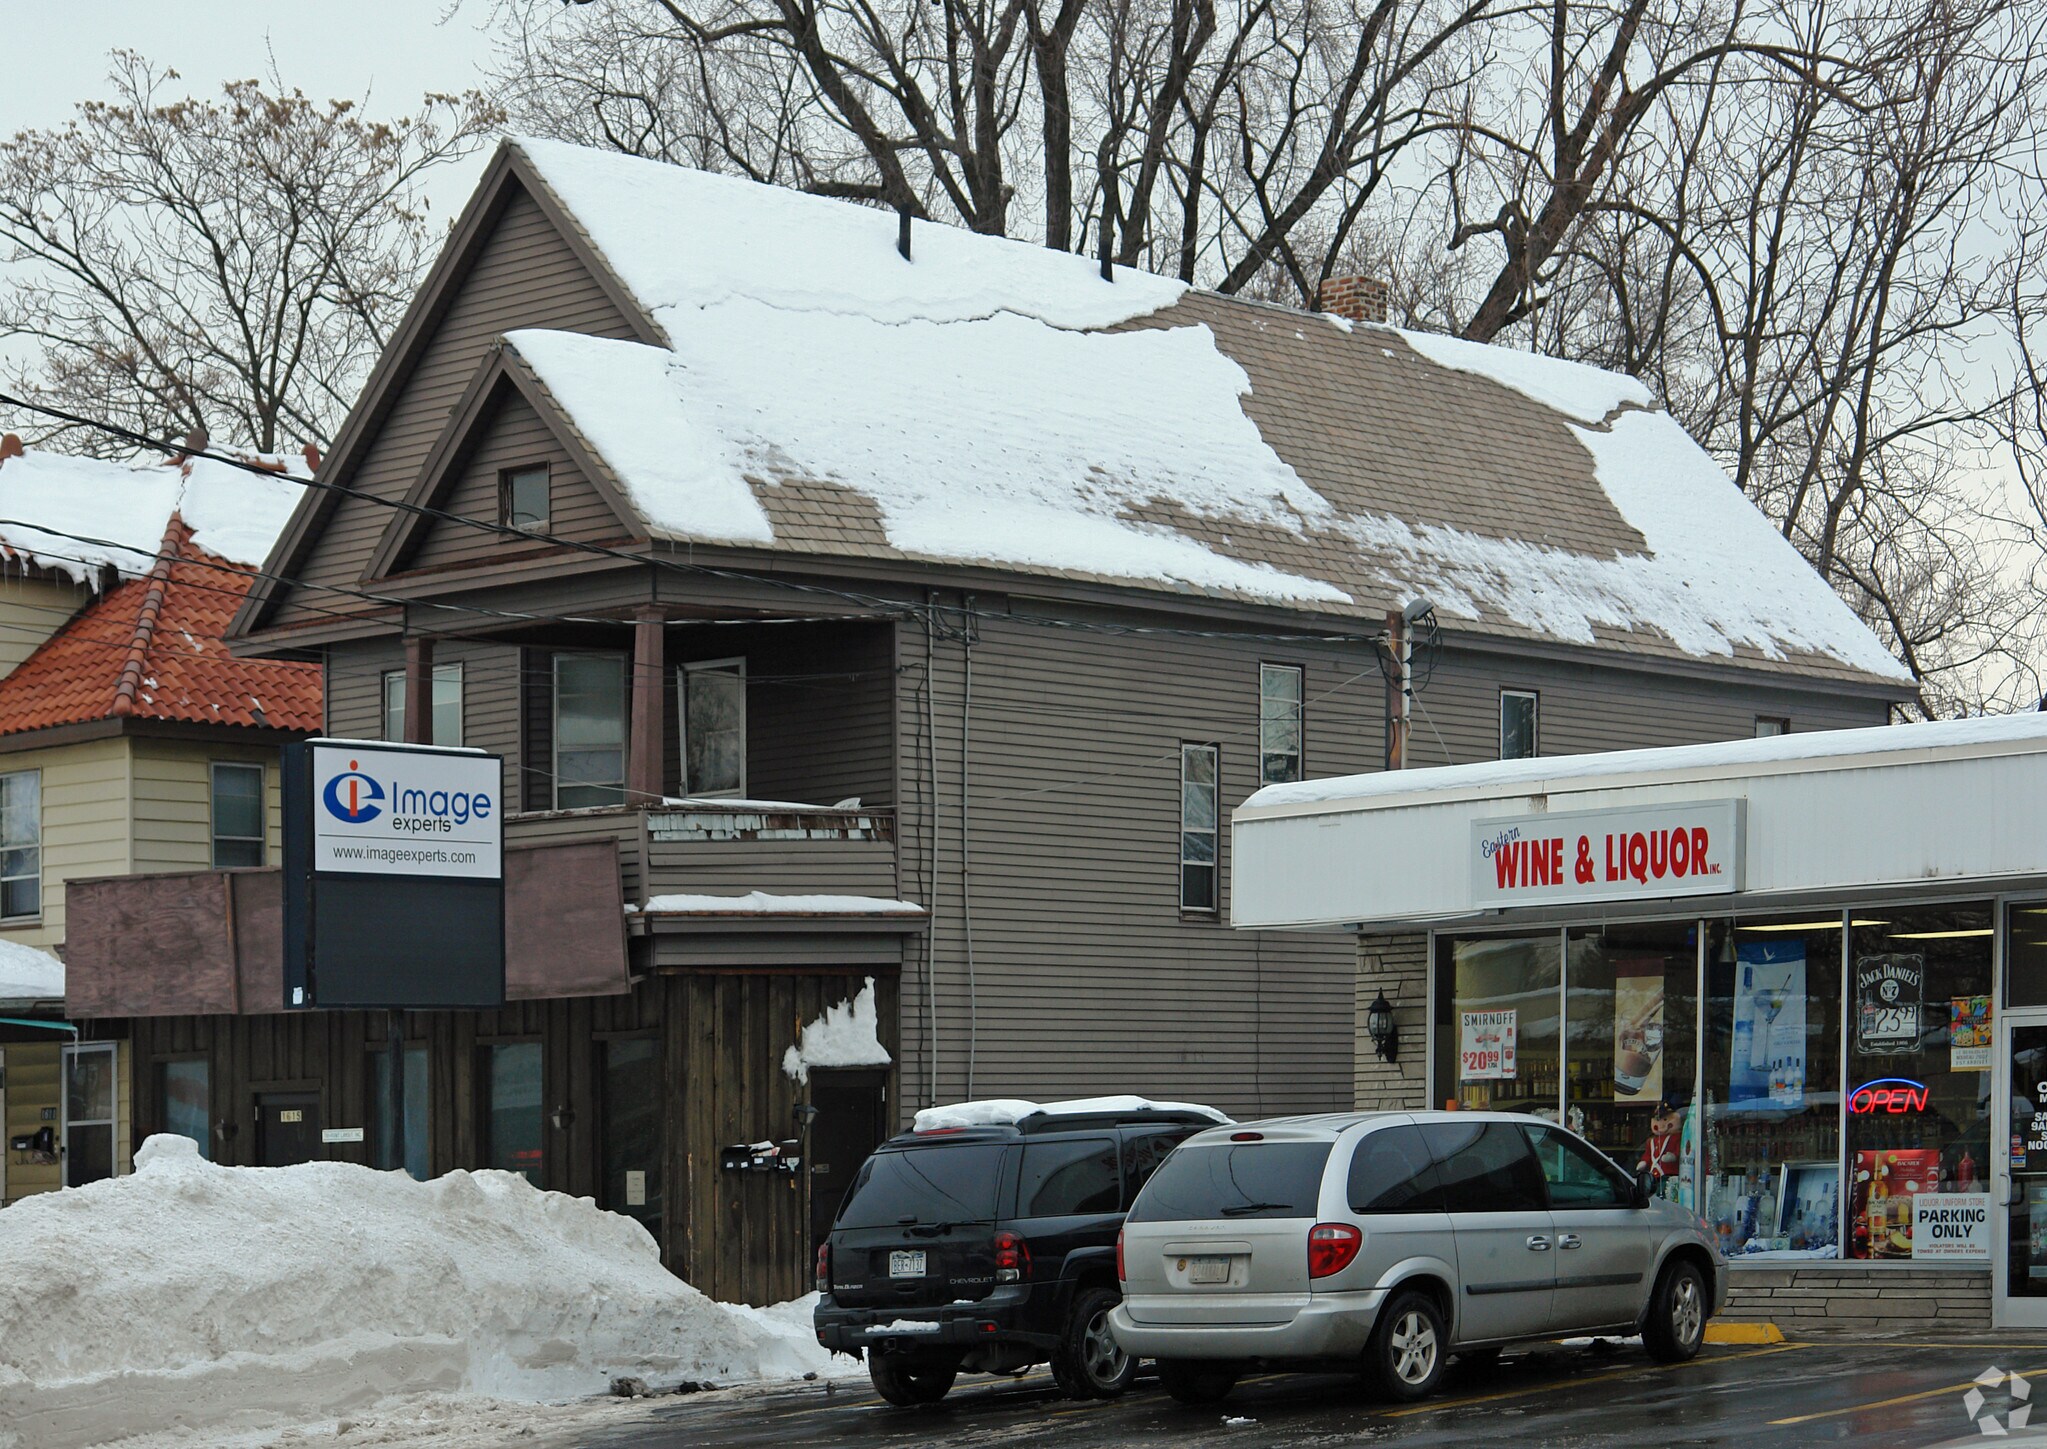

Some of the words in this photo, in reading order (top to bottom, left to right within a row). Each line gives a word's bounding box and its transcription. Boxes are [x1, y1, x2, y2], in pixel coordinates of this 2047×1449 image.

[393, 782, 491, 825] Image
[393, 817, 451, 834] experts
[1481, 827, 1520, 858] Eastern
[333, 846, 476, 864] www.imageexperts.com
[1495, 838, 1564, 889] WINE
[1575, 835, 1595, 884] &
[1606, 827, 1709, 885] LIQUOR
[1710, 863, 1722, 874] INC.
[1860, 967, 1883, 988] JACK
[1883, 964, 1920, 986] DANIEL'S
[1465, 1013, 1514, 1026] SMIRNOFF
[1852, 1088, 1929, 1113] OPEN
[1969, 1198, 1985, 1206] STORE
[1919, 1209, 1986, 1223] PARKING
[1932, 1224, 1973, 1238] ONLY
[949, 1276, 995, 1285] CHEVROLET
